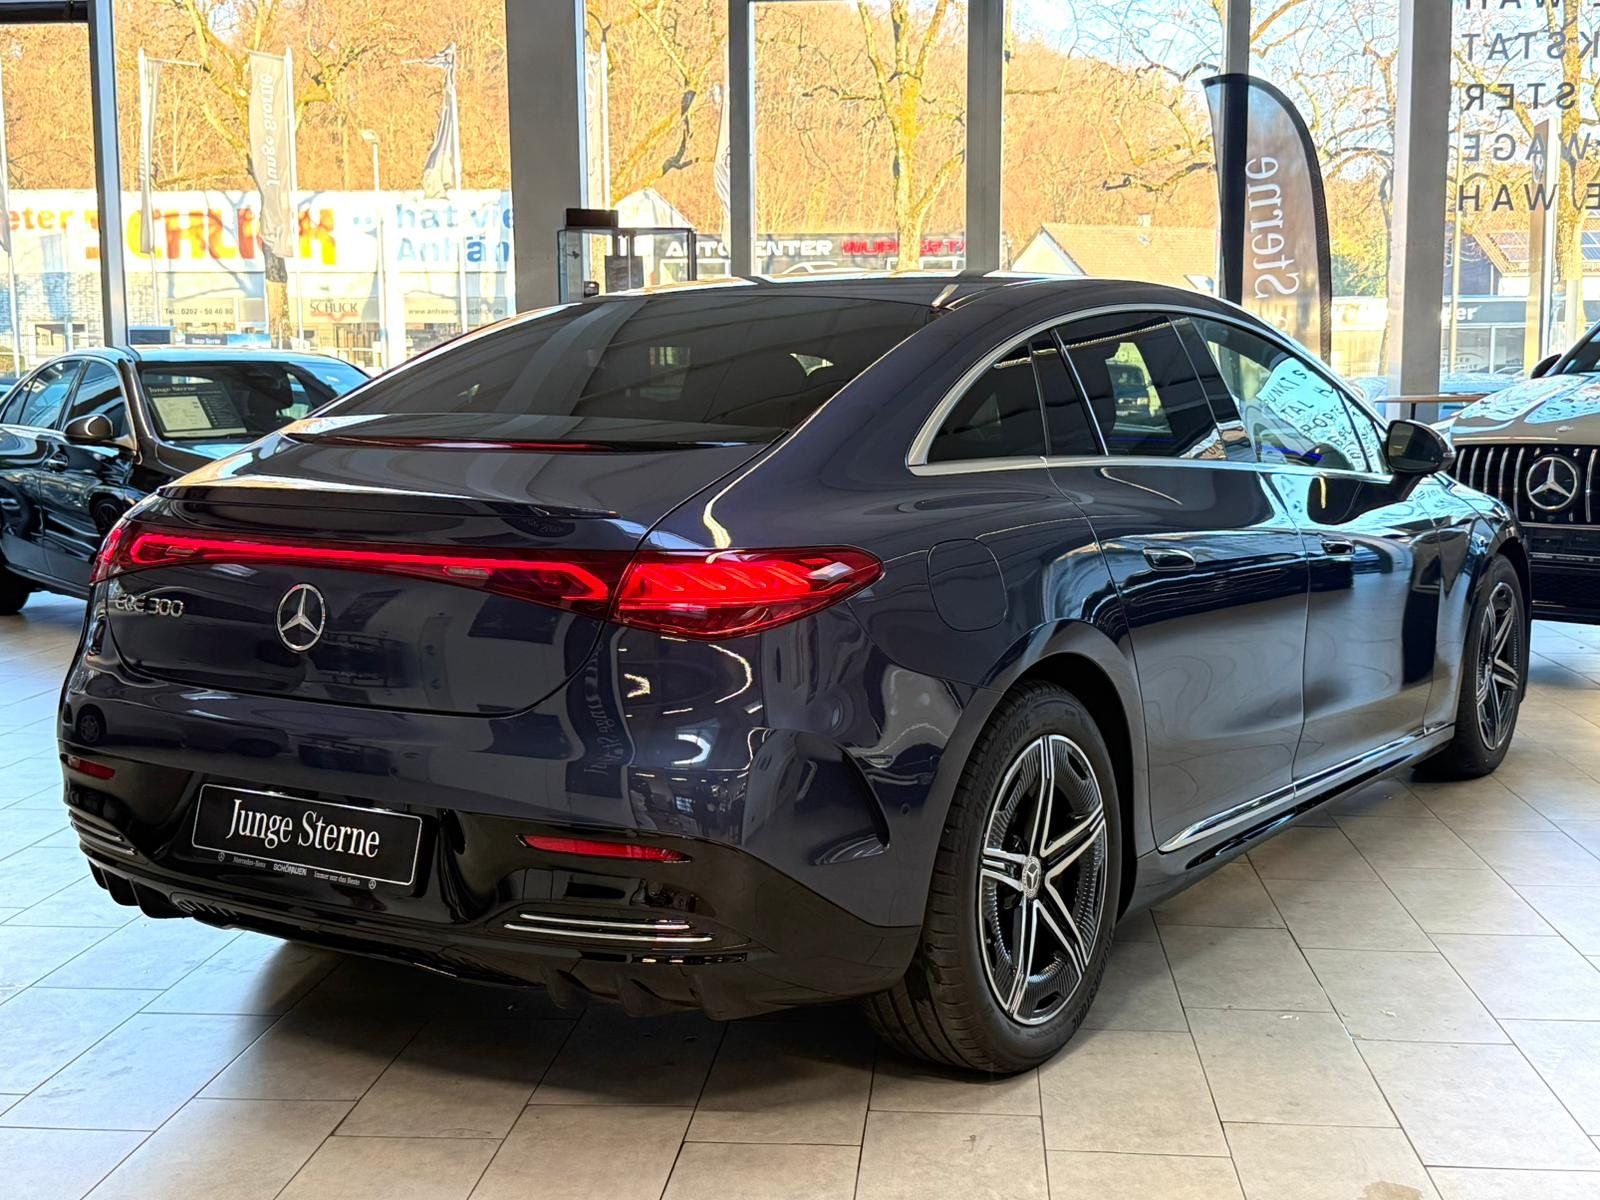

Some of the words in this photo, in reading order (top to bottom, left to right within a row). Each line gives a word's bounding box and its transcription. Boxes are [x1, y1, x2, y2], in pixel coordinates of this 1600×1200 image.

[5, 207, 73, 231] eter
[396, 203, 458, 229] hat
[84, 207, 337, 265] CHLIK
[147, 597, 184, 617] 300
[225, 799, 293, 849] Junge
[297, 810, 380, 858] Sterne
